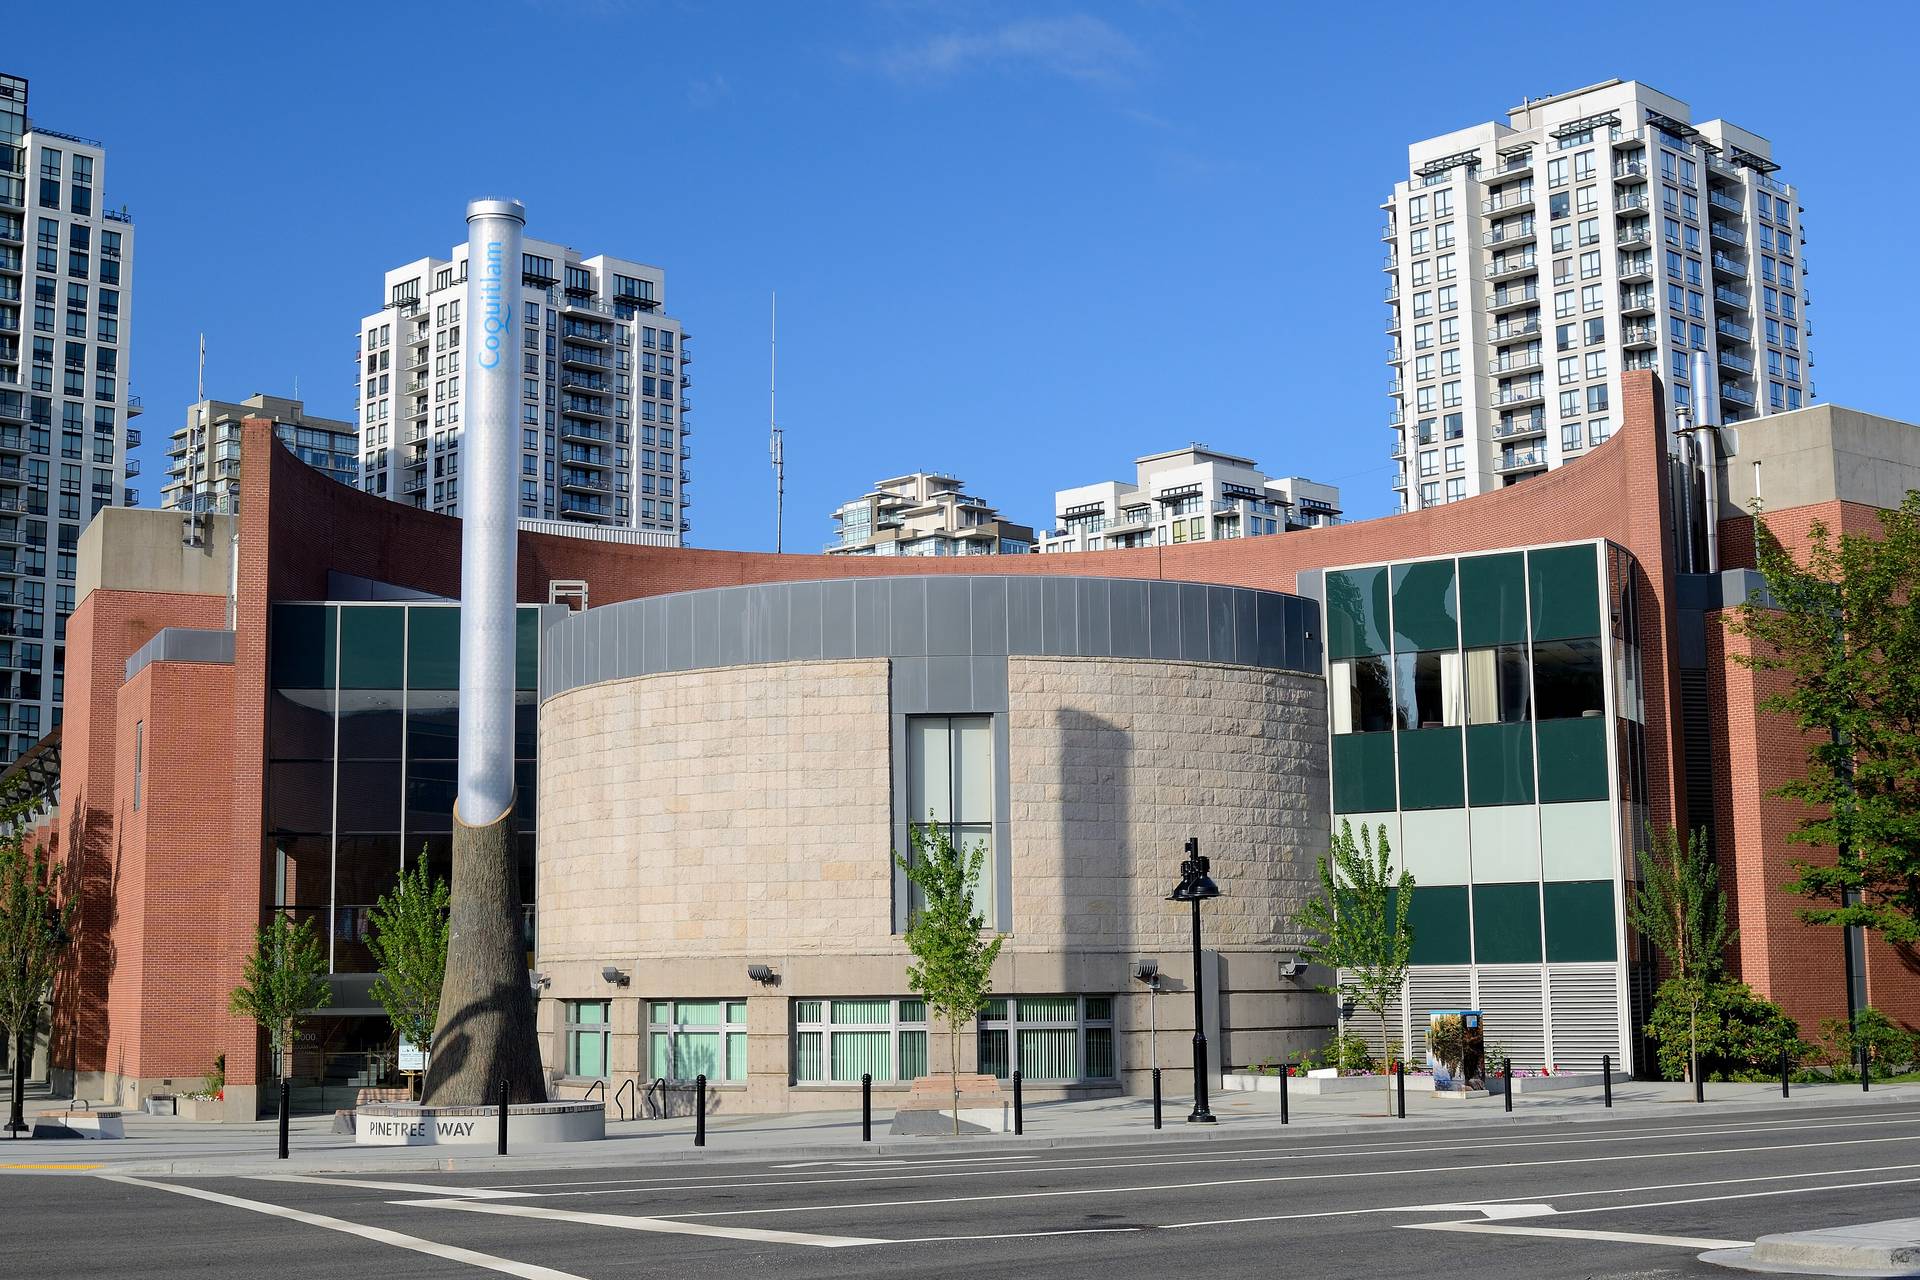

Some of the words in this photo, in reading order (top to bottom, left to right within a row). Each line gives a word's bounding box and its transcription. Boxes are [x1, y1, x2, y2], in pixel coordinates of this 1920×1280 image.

[479, 242, 511, 368] Coquitlam
[369, 1122, 425, 1137] PINETREE
[437, 1122, 475, 1137] WAY
